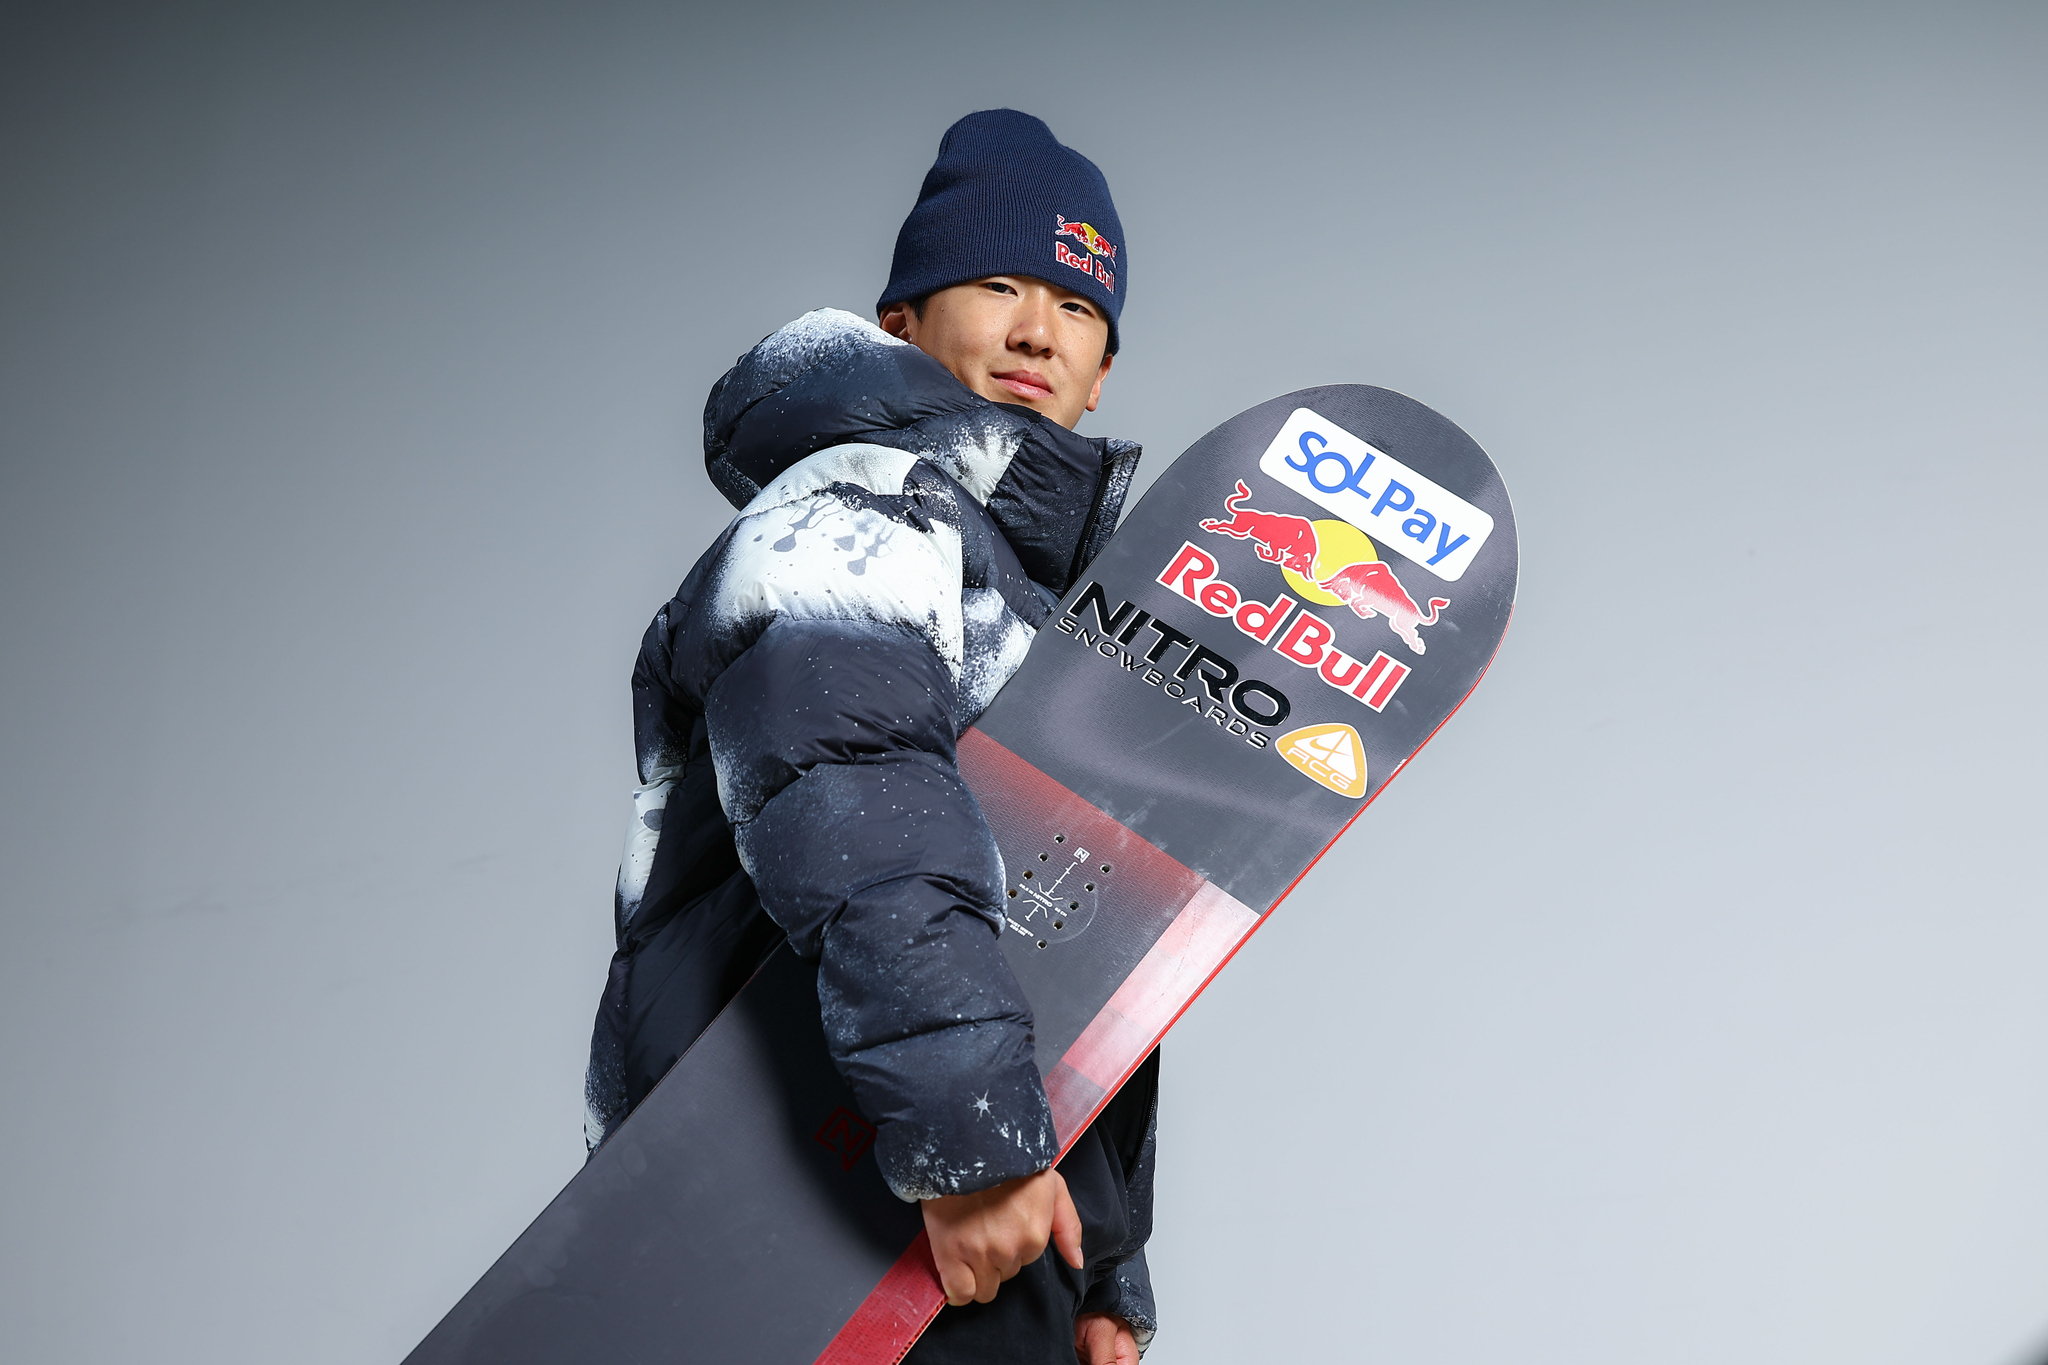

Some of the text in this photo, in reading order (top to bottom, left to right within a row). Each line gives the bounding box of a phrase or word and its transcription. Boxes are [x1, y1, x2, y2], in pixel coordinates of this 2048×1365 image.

[1055, 241, 1114, 294] Red Bull
[1370, 478, 1470, 566] Pay
[1066, 581, 1291, 727] NITRO
[1156, 541, 1411, 713] Red Bull
[1054, 616, 1271, 749] SNOWBOARDS
[1286, 747, 1352, 790] ACG
